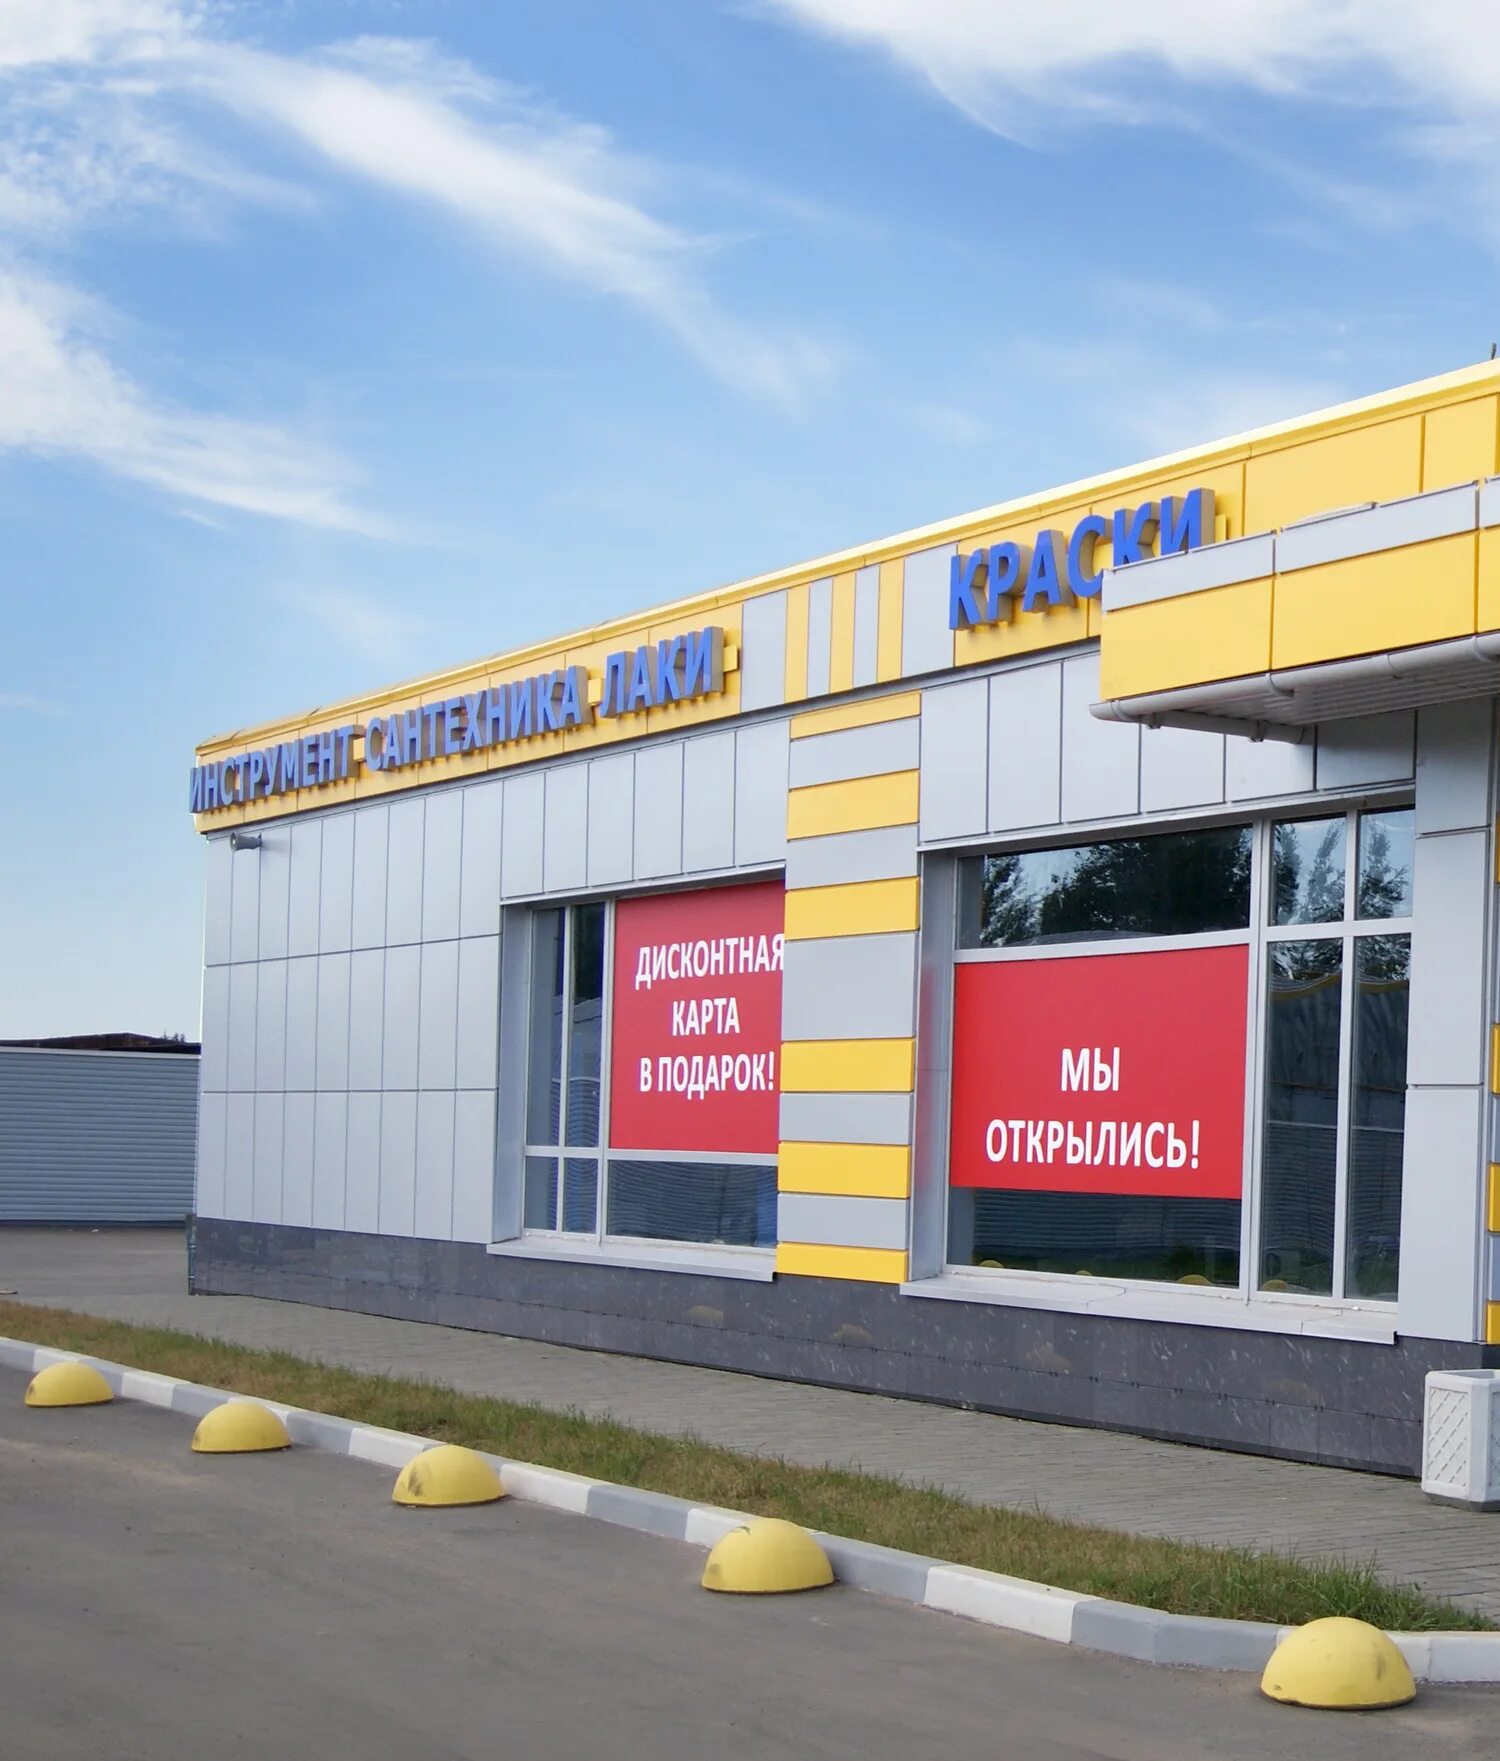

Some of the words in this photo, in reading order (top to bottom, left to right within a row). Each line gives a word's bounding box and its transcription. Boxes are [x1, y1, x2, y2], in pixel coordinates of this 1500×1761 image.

[949, 487, 1214, 631] КРАСКИ
[189, 725, 363, 814] ИНСТРУМЕНТ
[364, 665, 589, 773] САНТЕХНИКА
[600, 626, 724, 719] ЛАКИ
[635, 933, 785, 990] ДИСКОНТНАЯ
[672, 997, 741, 1036] КАРТА
[640, 1057, 652, 1092] В
[658, 1051, 775, 1100] ПОДАРОК!
[1061, 1047, 1120, 1091] МЫ
[986, 1119, 1199, 1169] ОТКРЫЛИСЬ!
